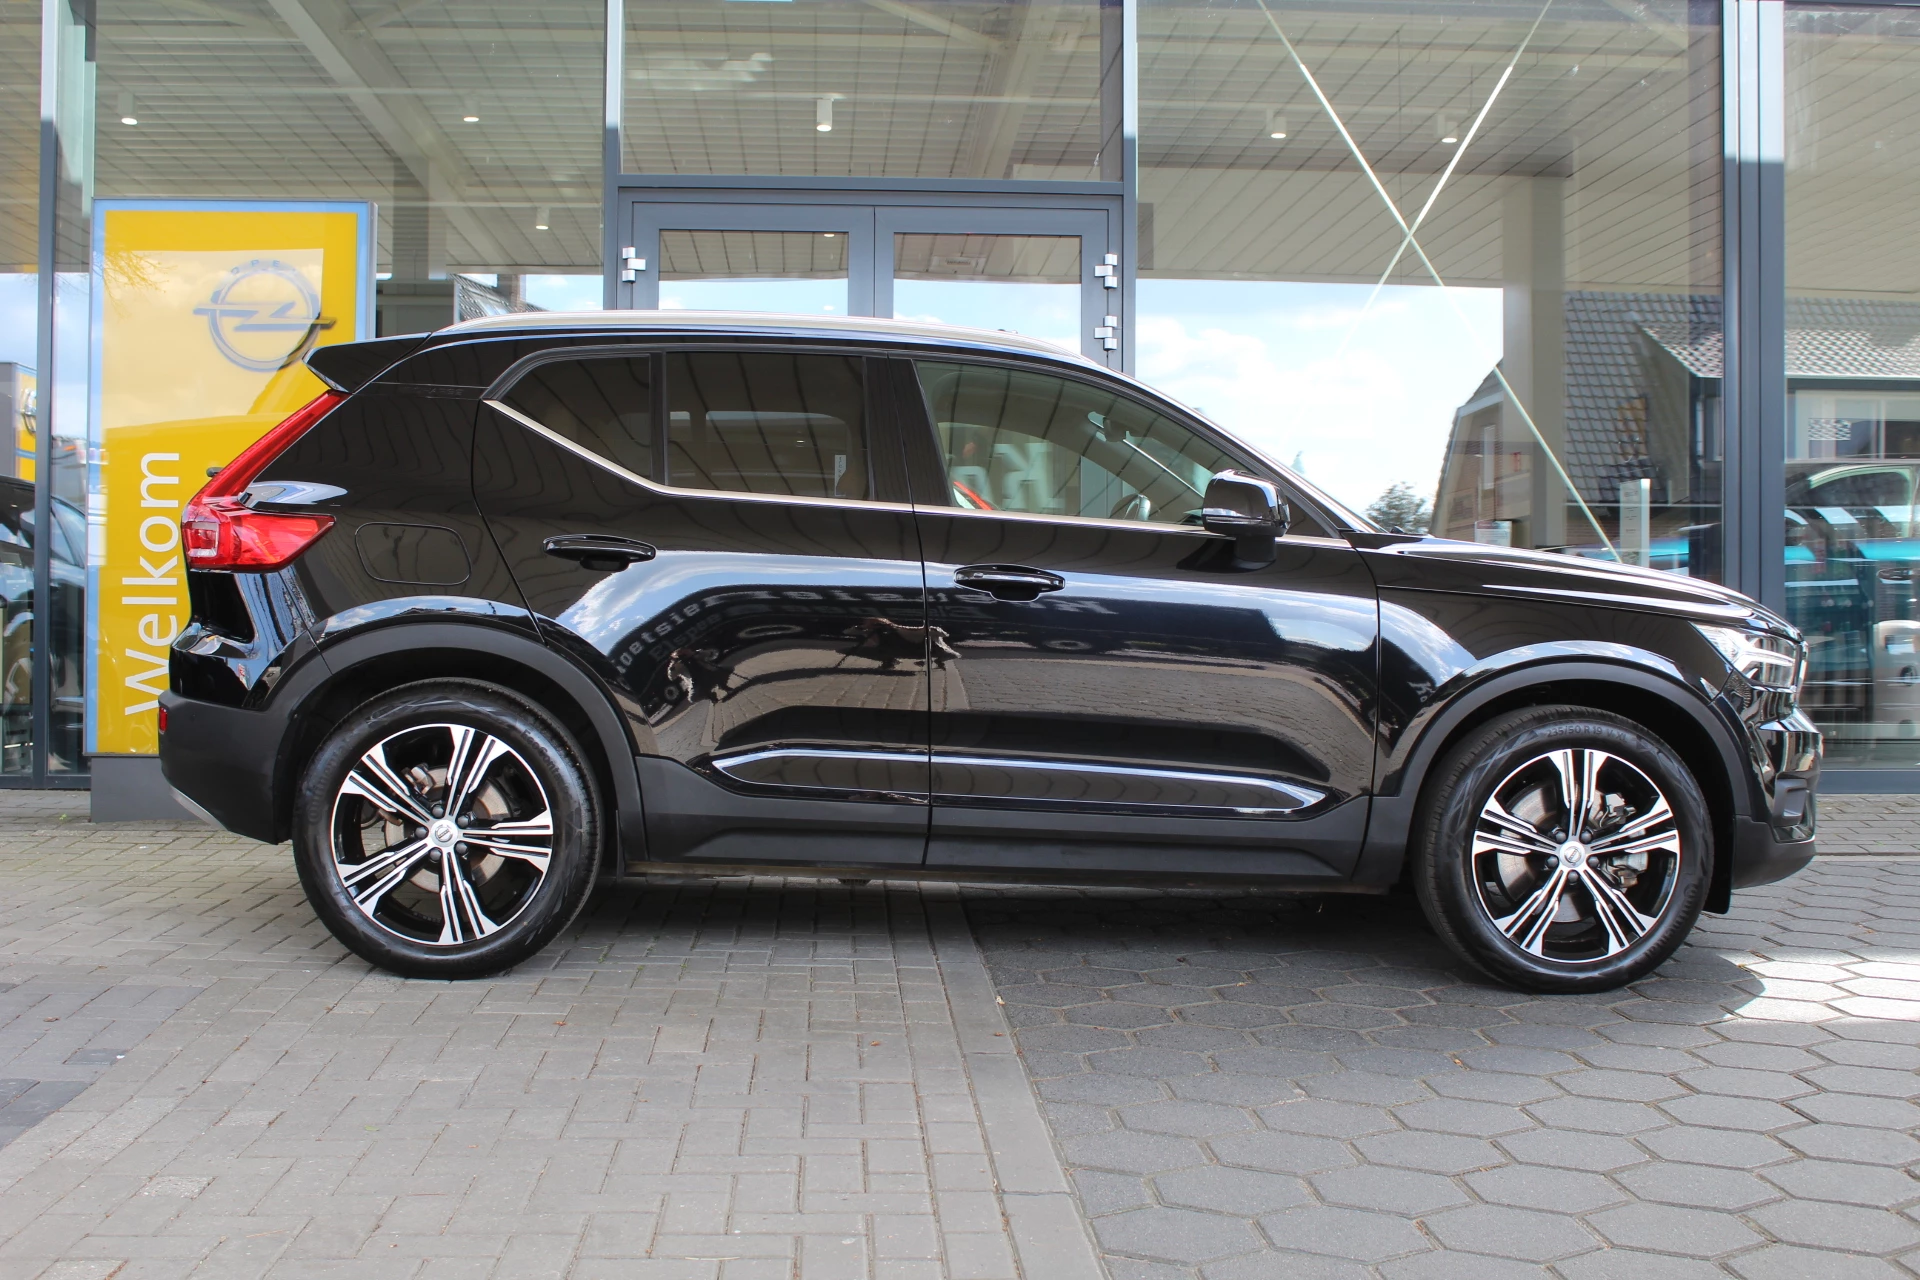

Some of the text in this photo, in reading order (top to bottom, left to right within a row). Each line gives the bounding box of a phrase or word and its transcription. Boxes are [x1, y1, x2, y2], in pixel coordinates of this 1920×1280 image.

[121, 452, 180, 716] Welkom
[1547, 724, 1582, 738] 235/50
[1583, 725, 1591, 735] R
[1592, 725, 1602, 736] 19
